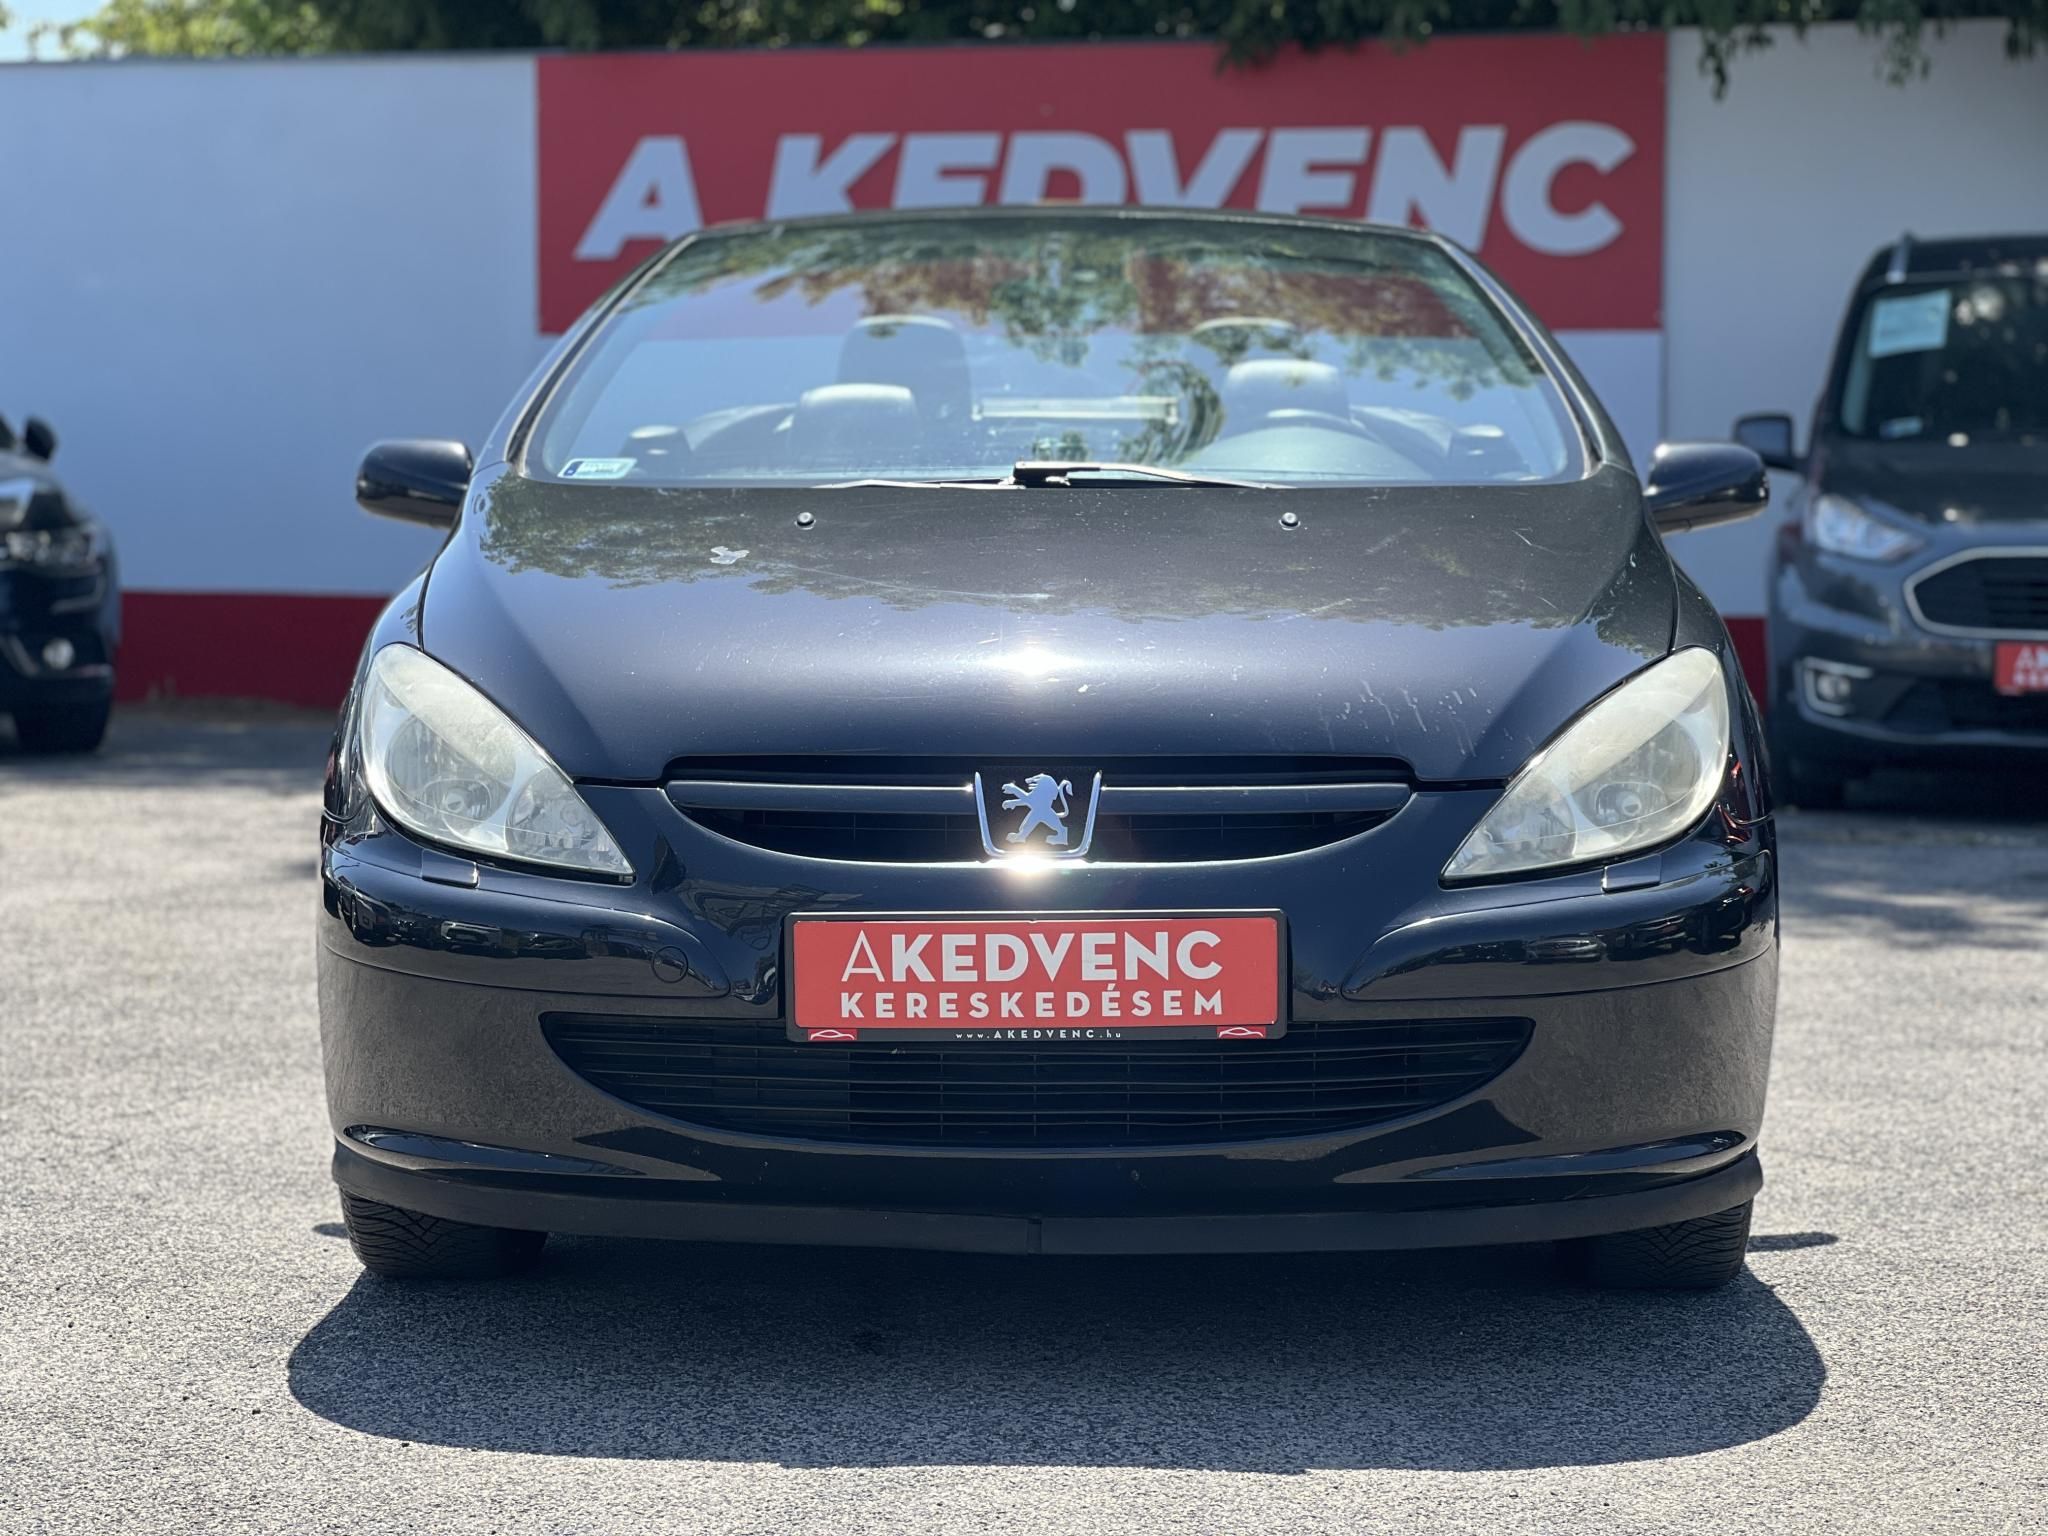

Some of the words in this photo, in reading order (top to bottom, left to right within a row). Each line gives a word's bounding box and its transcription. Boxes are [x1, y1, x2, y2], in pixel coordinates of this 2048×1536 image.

[572, 135, 704, 261] A
[765, 120, 1637, 256] KEDVENC
[840, 983, 1223, 1019] KERESKEDÉSEM
[955, 1028, 1122, 1040] www.AKEDVENC.hu
